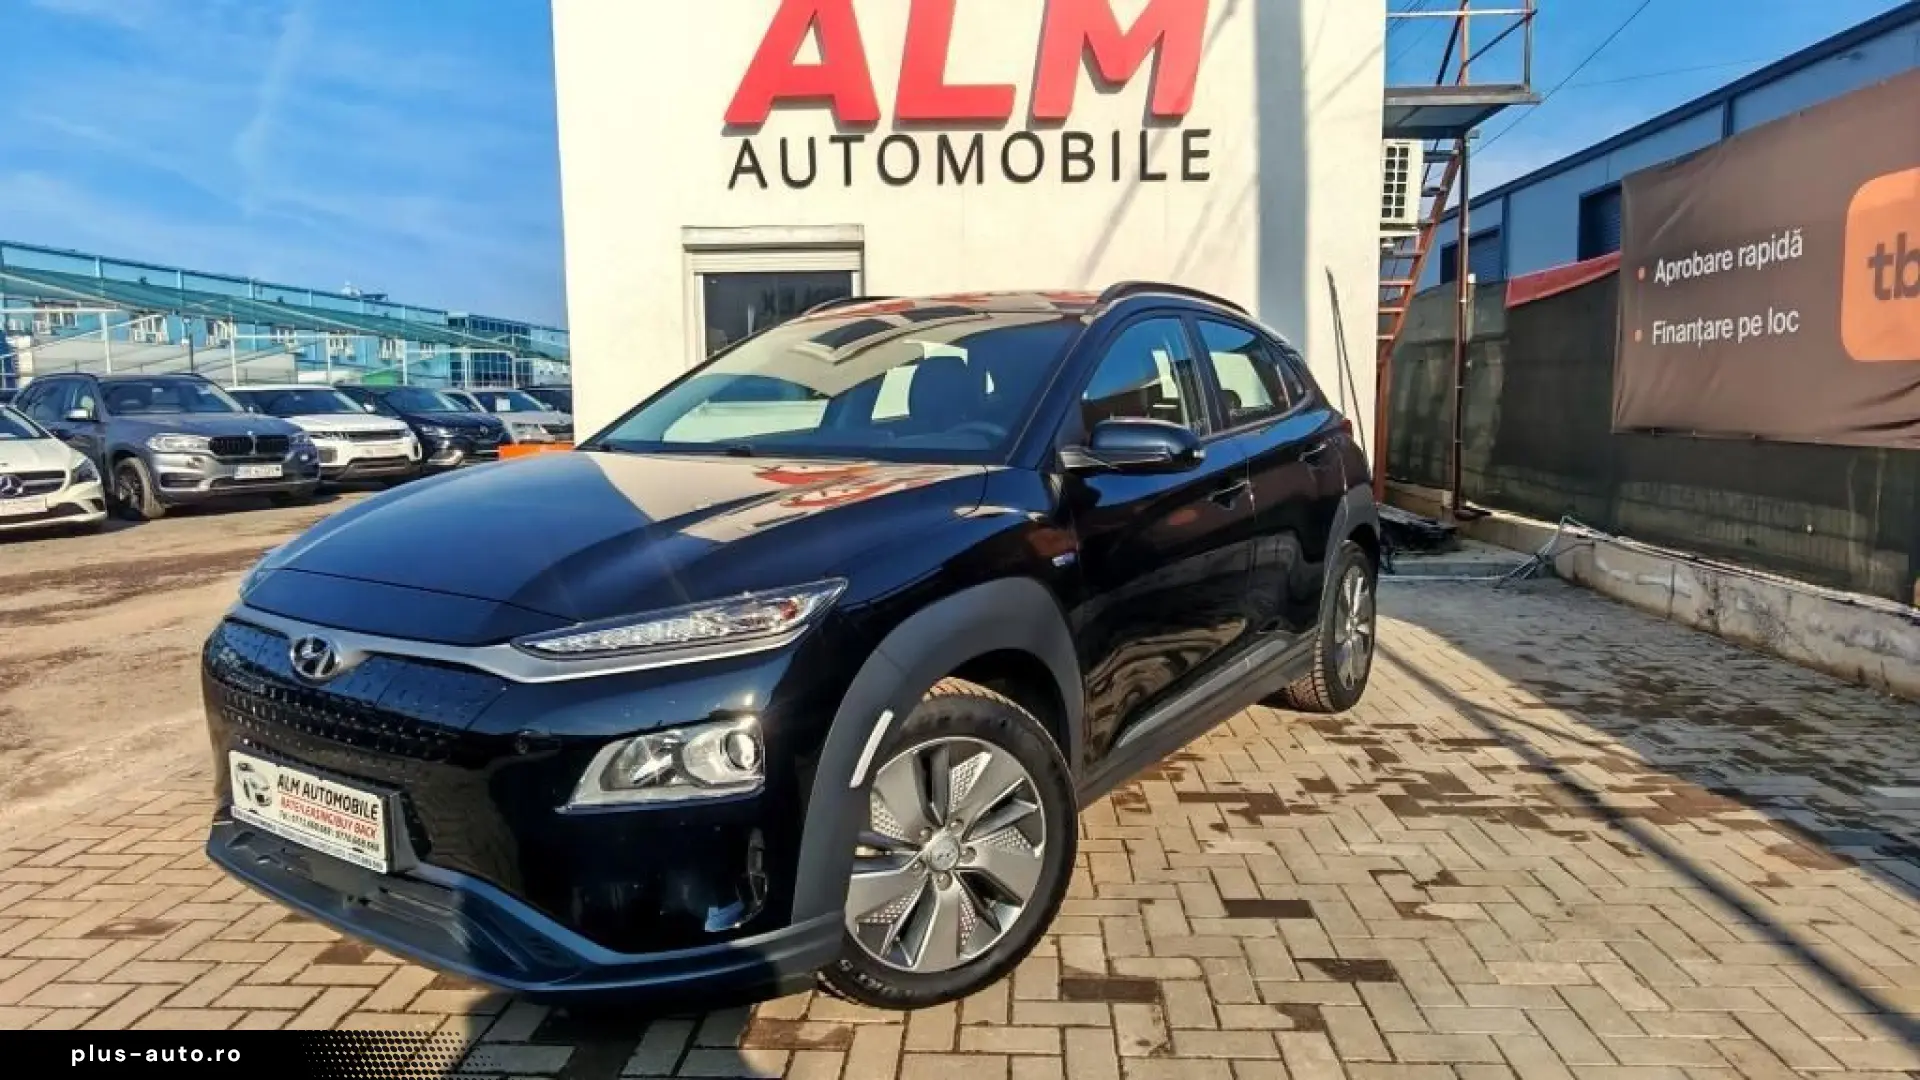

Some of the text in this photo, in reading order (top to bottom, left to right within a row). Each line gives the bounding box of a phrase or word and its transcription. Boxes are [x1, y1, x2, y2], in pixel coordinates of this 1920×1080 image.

[723, 0, 1210, 125] ALM
[728, 129, 1211, 189] AUTOMOBILE
[1653, 228, 1803, 287] Aprobare rapidă
[1652, 307, 1800, 347] Finanțare pe loc
[277, 774, 300, 796] ALM
[302, 781, 379, 821] AUTOMOBILE
[354, 822, 377, 839] BACK
